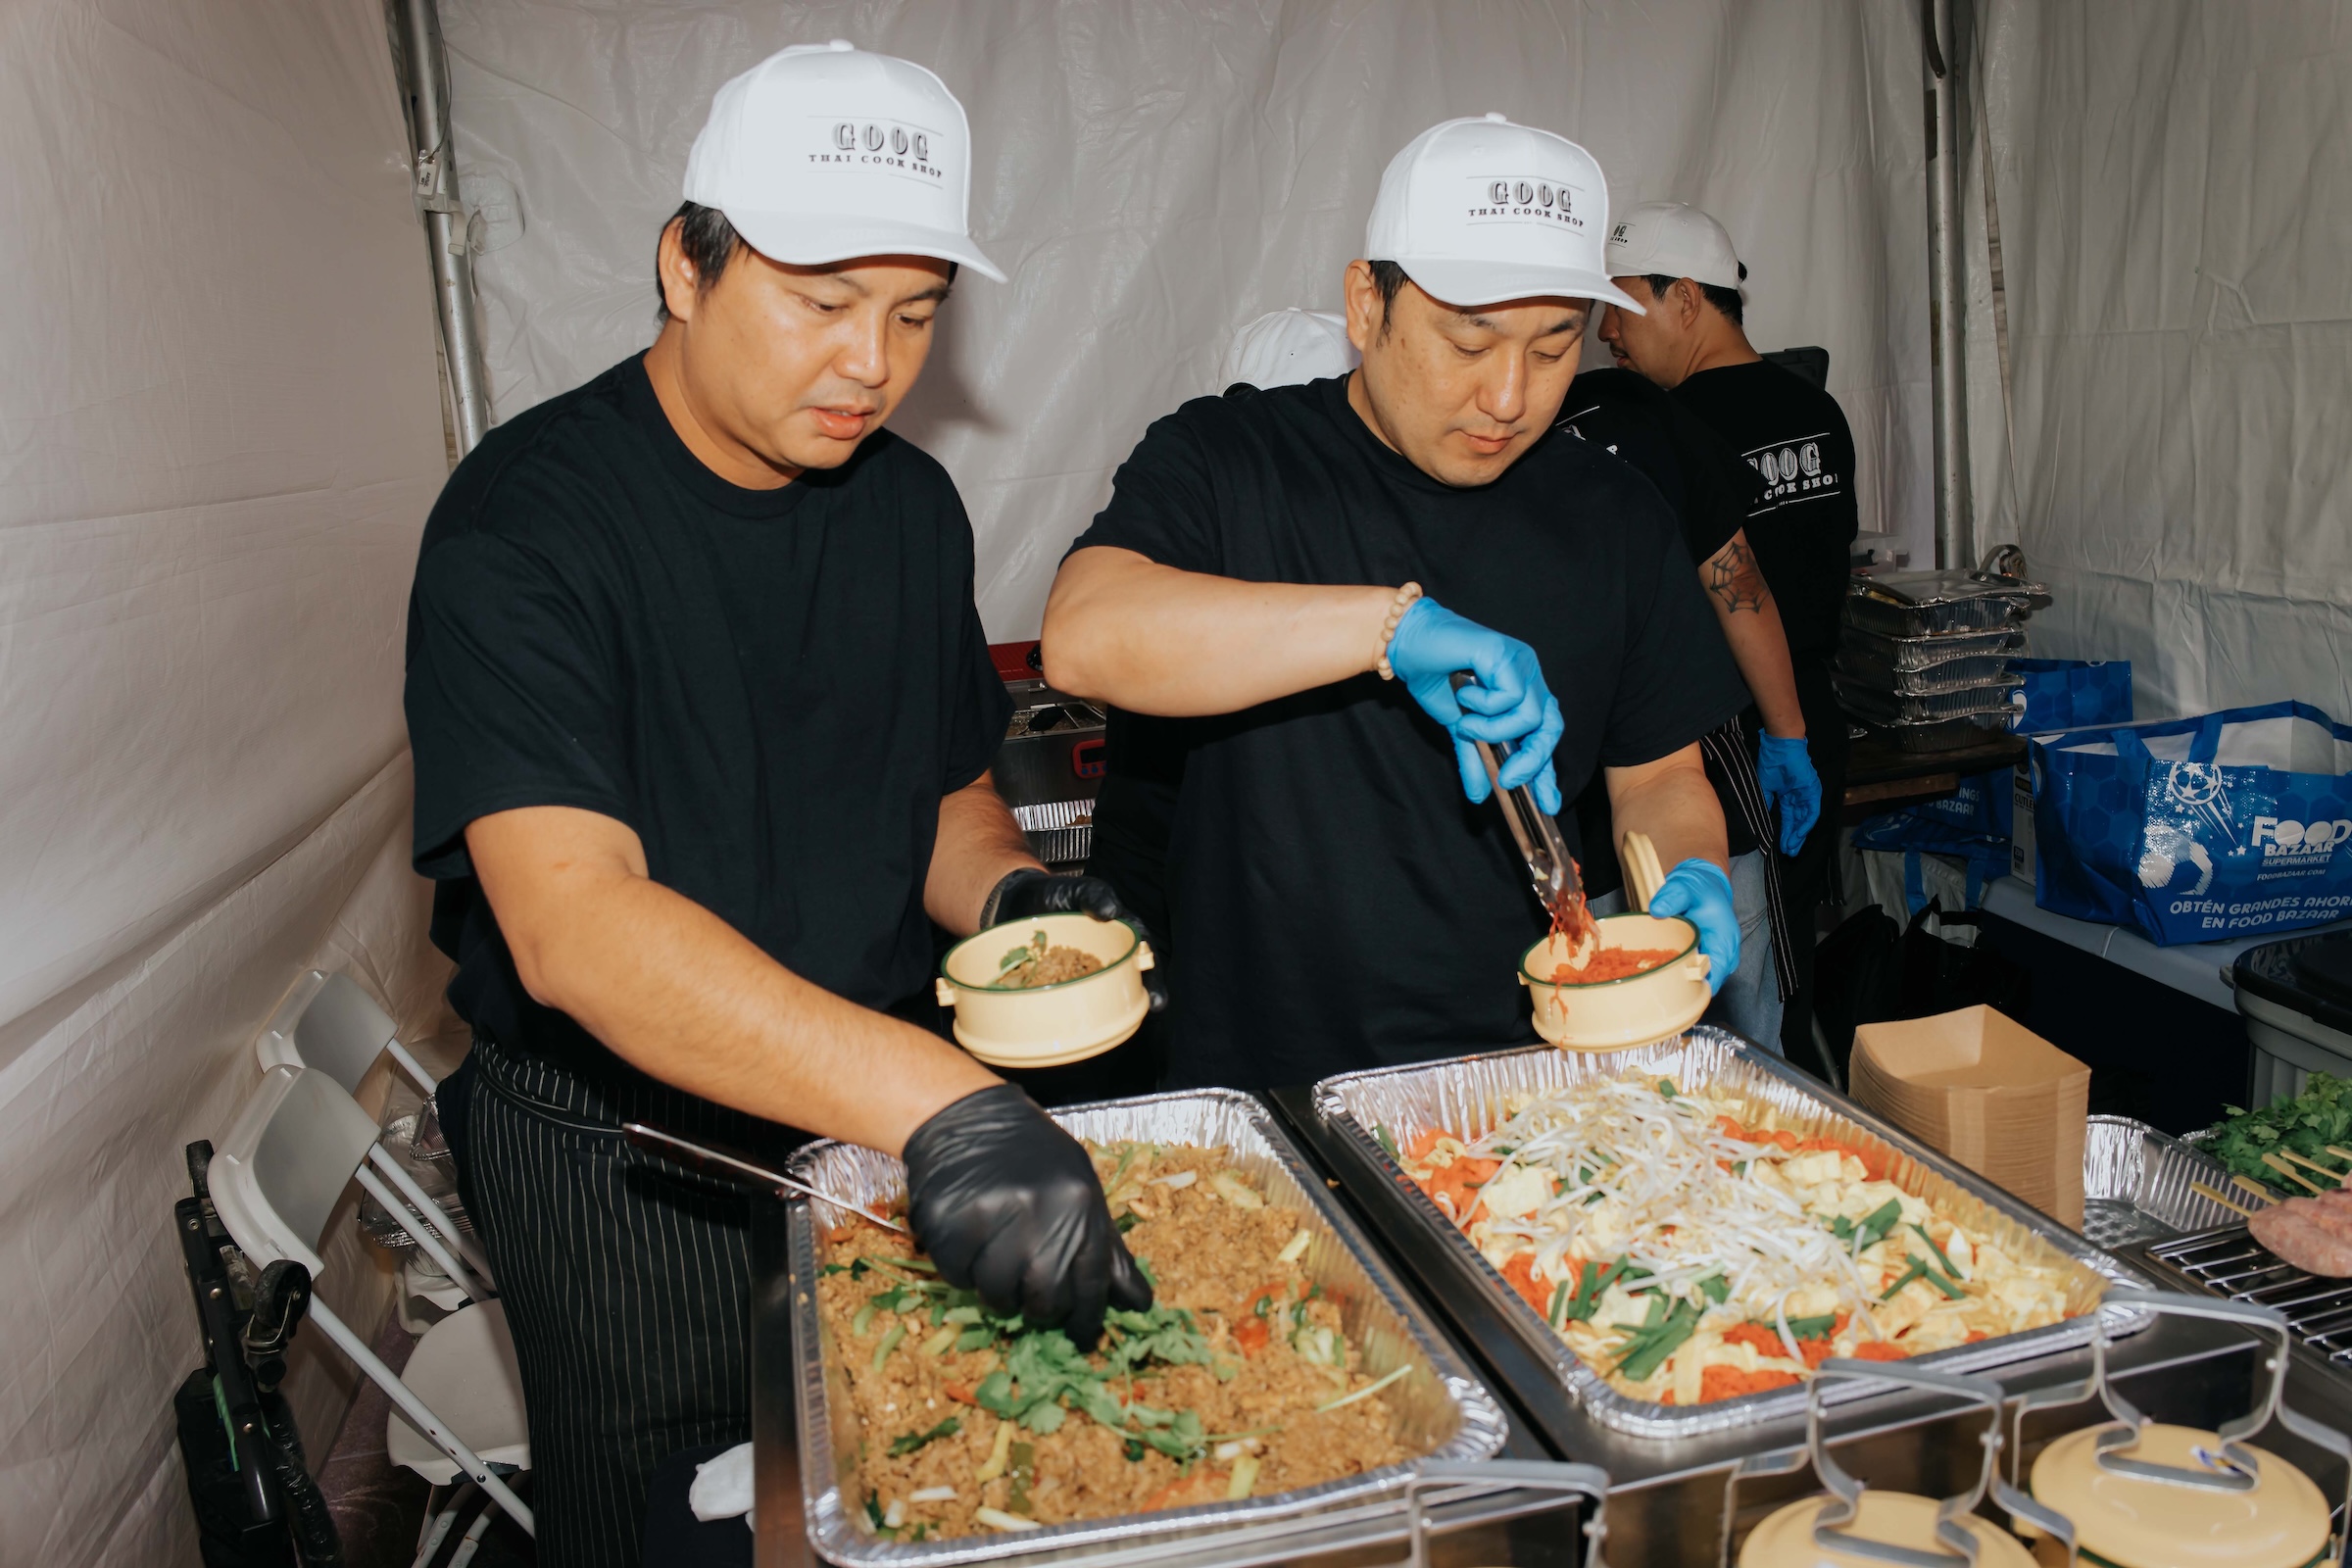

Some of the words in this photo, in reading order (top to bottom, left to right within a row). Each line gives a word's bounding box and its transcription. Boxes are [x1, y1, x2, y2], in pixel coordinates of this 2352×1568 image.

[831, 122, 929, 162] GOOG
[808, 154, 852, 163] THAI
[860, 155, 906, 168] COOK
[911, 163, 943, 178] SHOP
[1487, 180, 1572, 214] GOOG
[1468, 208, 1506, 218] THAI
[1512, 208, 1552, 219] COOK
[1556, 213, 1585, 227] SHOP
[1613, 224, 1628, 237] OG
[1747, 442, 1822, 486] OOG
[1802, 473, 1838, 491] SHO
[1958, 787, 1981, 802] INGS
[2014, 793, 2035, 810] CUTLE
[2252, 815, 2352, 848] FOOD
[2264, 841, 2335, 858] BAZAAR
[2262, 854, 2332, 865] SUPERMARKET
[2256, 869, 2327, 881] FOODBAZAAR.COM
[2169, 899, 2226, 915] OBTÉN
[2229, 896, 2300, 915] GRANDES
[2304, 895, 2352, 911] AHOR
[2201, 916, 2225, 929] EN
[2228, 912, 2274, 929] FOOD
[2276, 908, 2340, 923] BAZAAR
